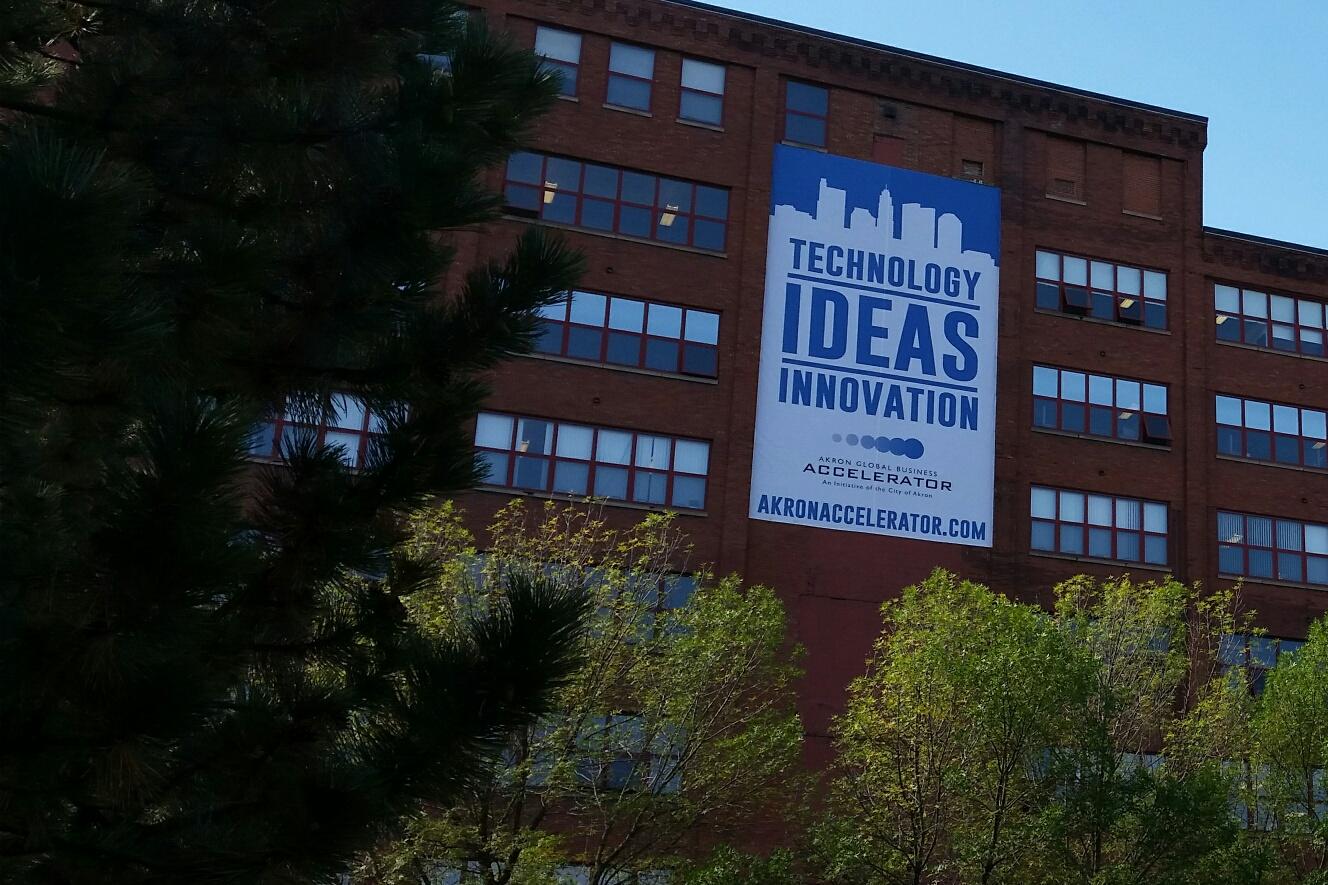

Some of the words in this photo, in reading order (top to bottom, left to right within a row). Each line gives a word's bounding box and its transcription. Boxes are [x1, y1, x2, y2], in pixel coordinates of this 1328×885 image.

[789, 238, 981, 301] TECHNOLOGY
[782, 282, 979, 381] IDEAS
[778, 367, 978, 431] INNOVATION
[803, 463, 952, 492] ACCELERATOR
[818, 456, 852, 466] AKRON
[856, 460, 892, 471] GLOBAL
[896, 466, 938, 477] BUSINESS
[833, 481, 863, 489] Initiative
[888, 487, 901, 495] City
[757, 494, 986, 540] AKRONACCELERATOR.COM
